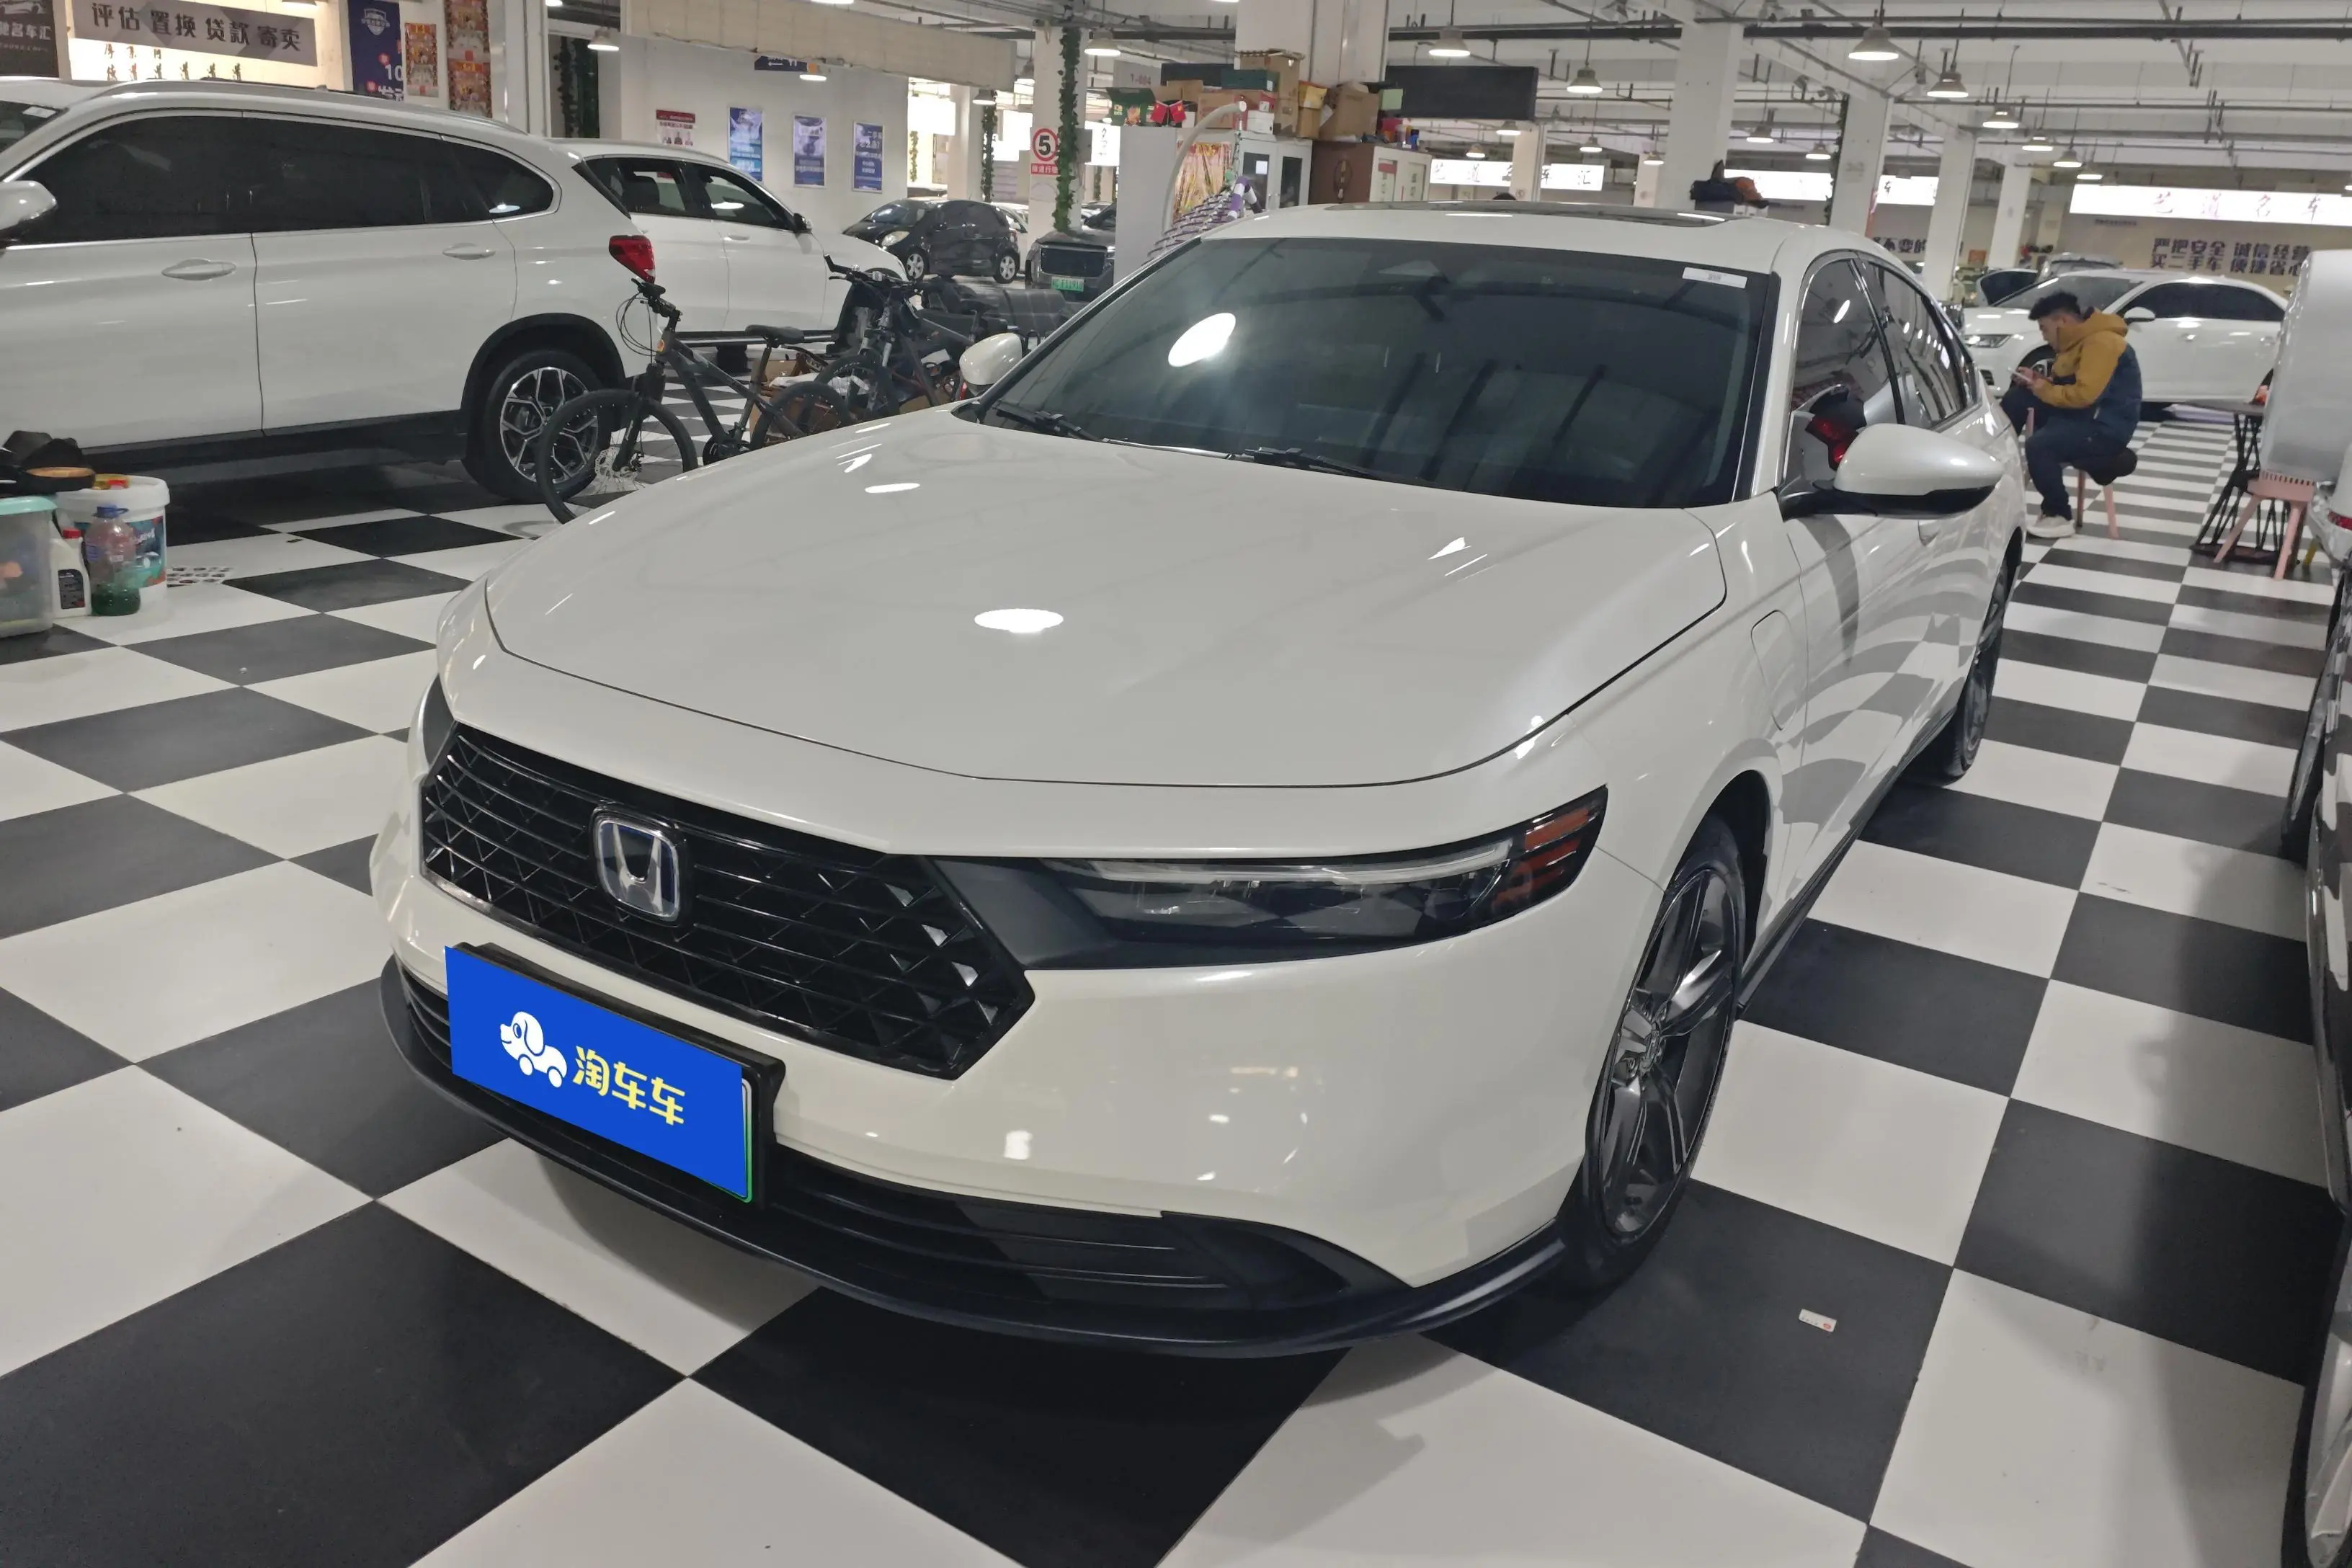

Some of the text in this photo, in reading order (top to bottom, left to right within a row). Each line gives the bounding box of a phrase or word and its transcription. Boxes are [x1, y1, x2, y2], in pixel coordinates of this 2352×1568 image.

[92, 2, 302, 52] 评估 置换 贷款 寄卖
[1038, 135, 1051, 156] 5
[2152, 237, 2226, 257] 严把安全
[2151, 254, 2222, 271] 买二手车
